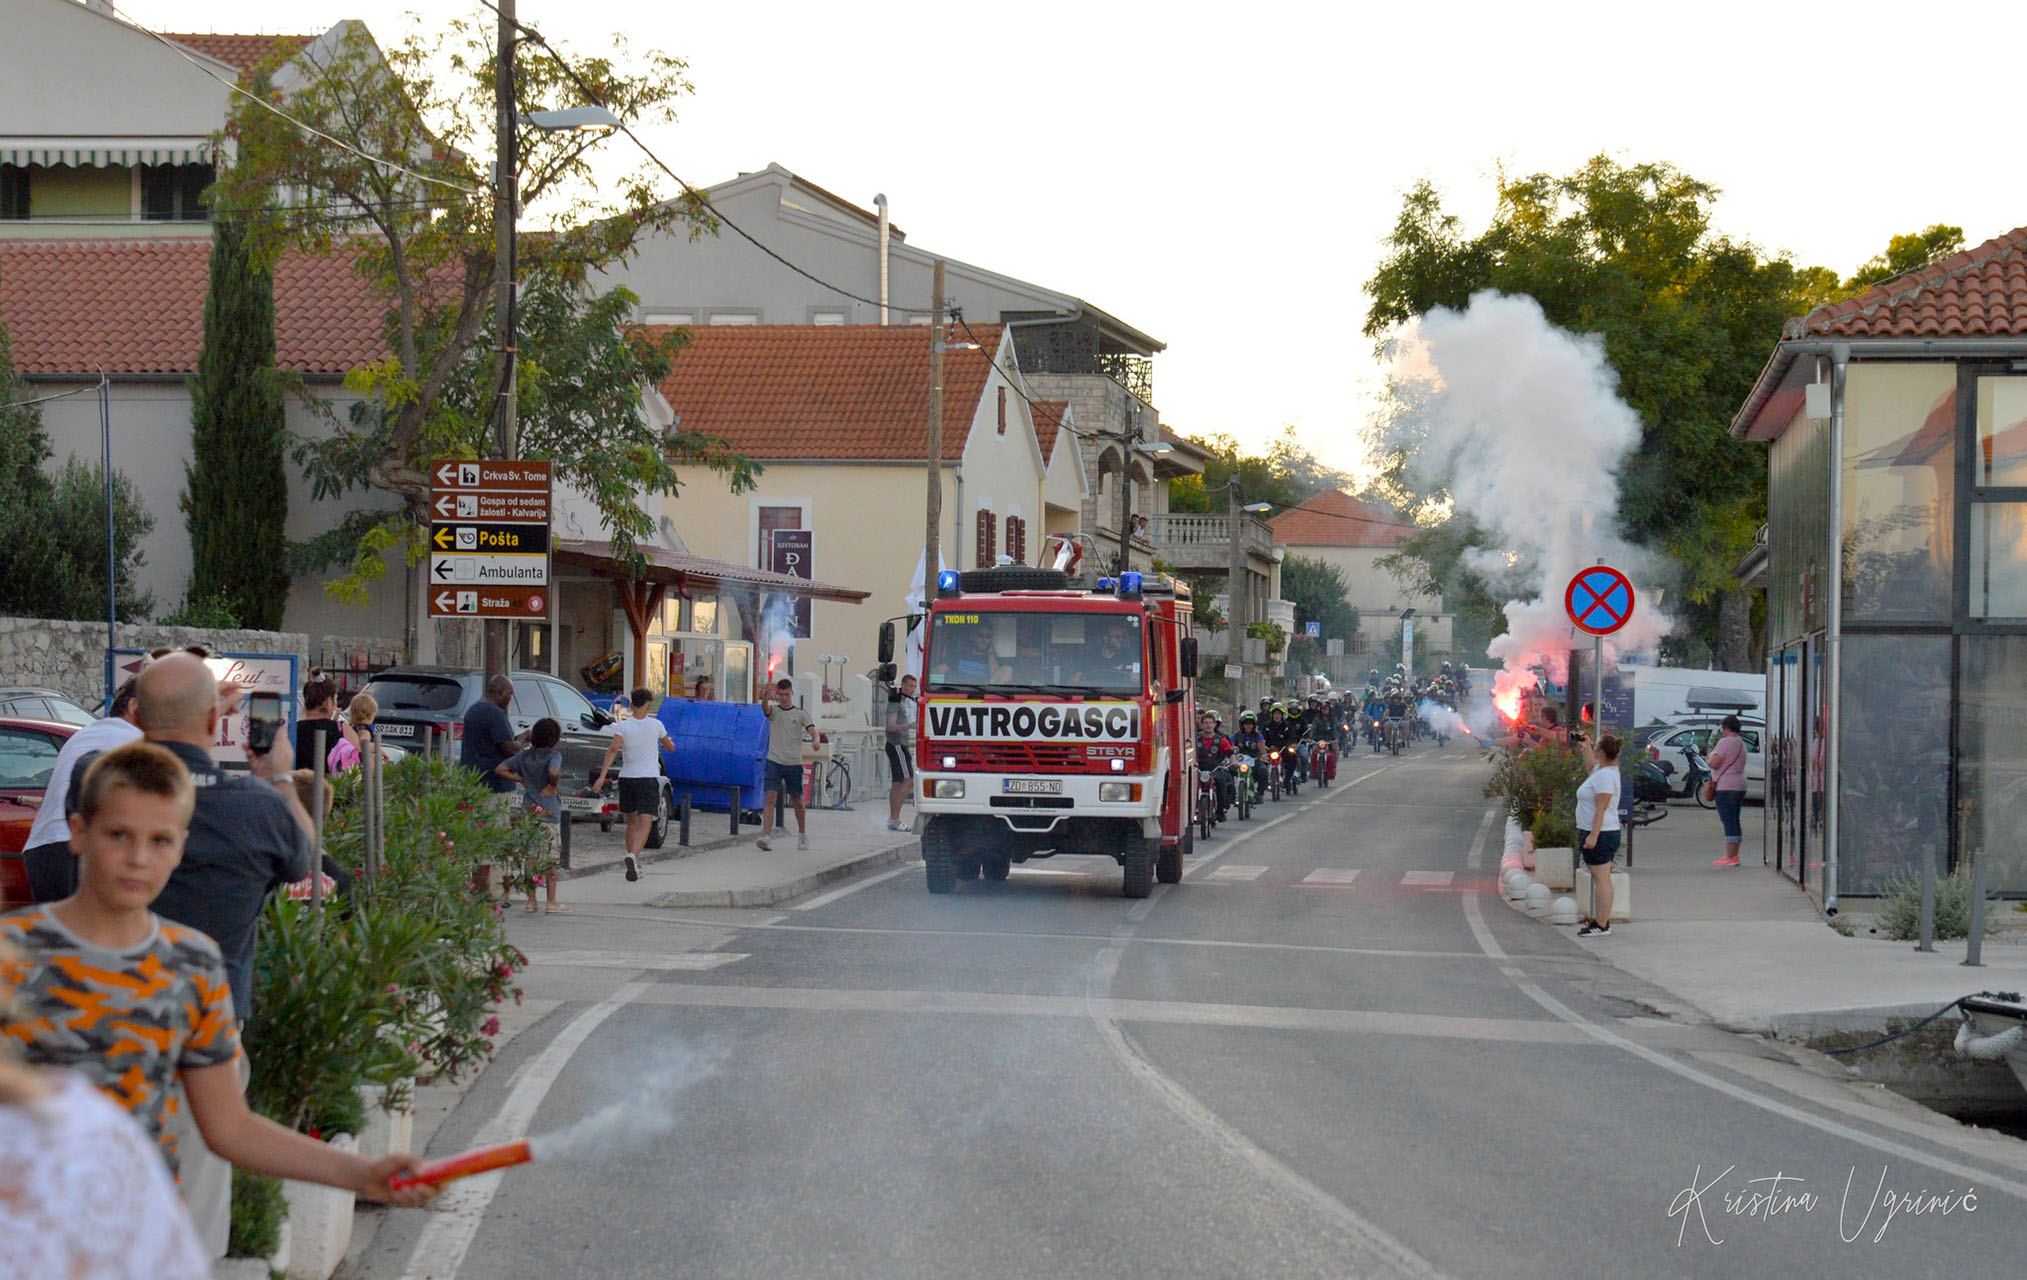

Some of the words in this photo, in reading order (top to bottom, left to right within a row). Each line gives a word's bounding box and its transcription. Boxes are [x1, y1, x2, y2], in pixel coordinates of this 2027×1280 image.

[483, 470, 508, 480] Crkva
[508, 470, 521, 480] Sv.
[523, 471, 547, 481] Tome
[480, 496, 506, 507] Gospa
[507, 497, 518, 506] od
[519, 497, 546, 506] sedam
[480, 508, 506, 517] žalosti
[512, 508, 547, 519] Kalvarija
[480, 531, 519, 546] Pošta
[479, 565, 543, 579] Ambulanta
[482, 597, 510, 608] Straža
[945, 615, 965, 625] TKON
[966, 615, 979, 625] 110
[928, 706, 1139, 740] VATROGASCI
[1086, 746, 1136, 756] STEYR
[1010, 781, 1021, 791] ZD
